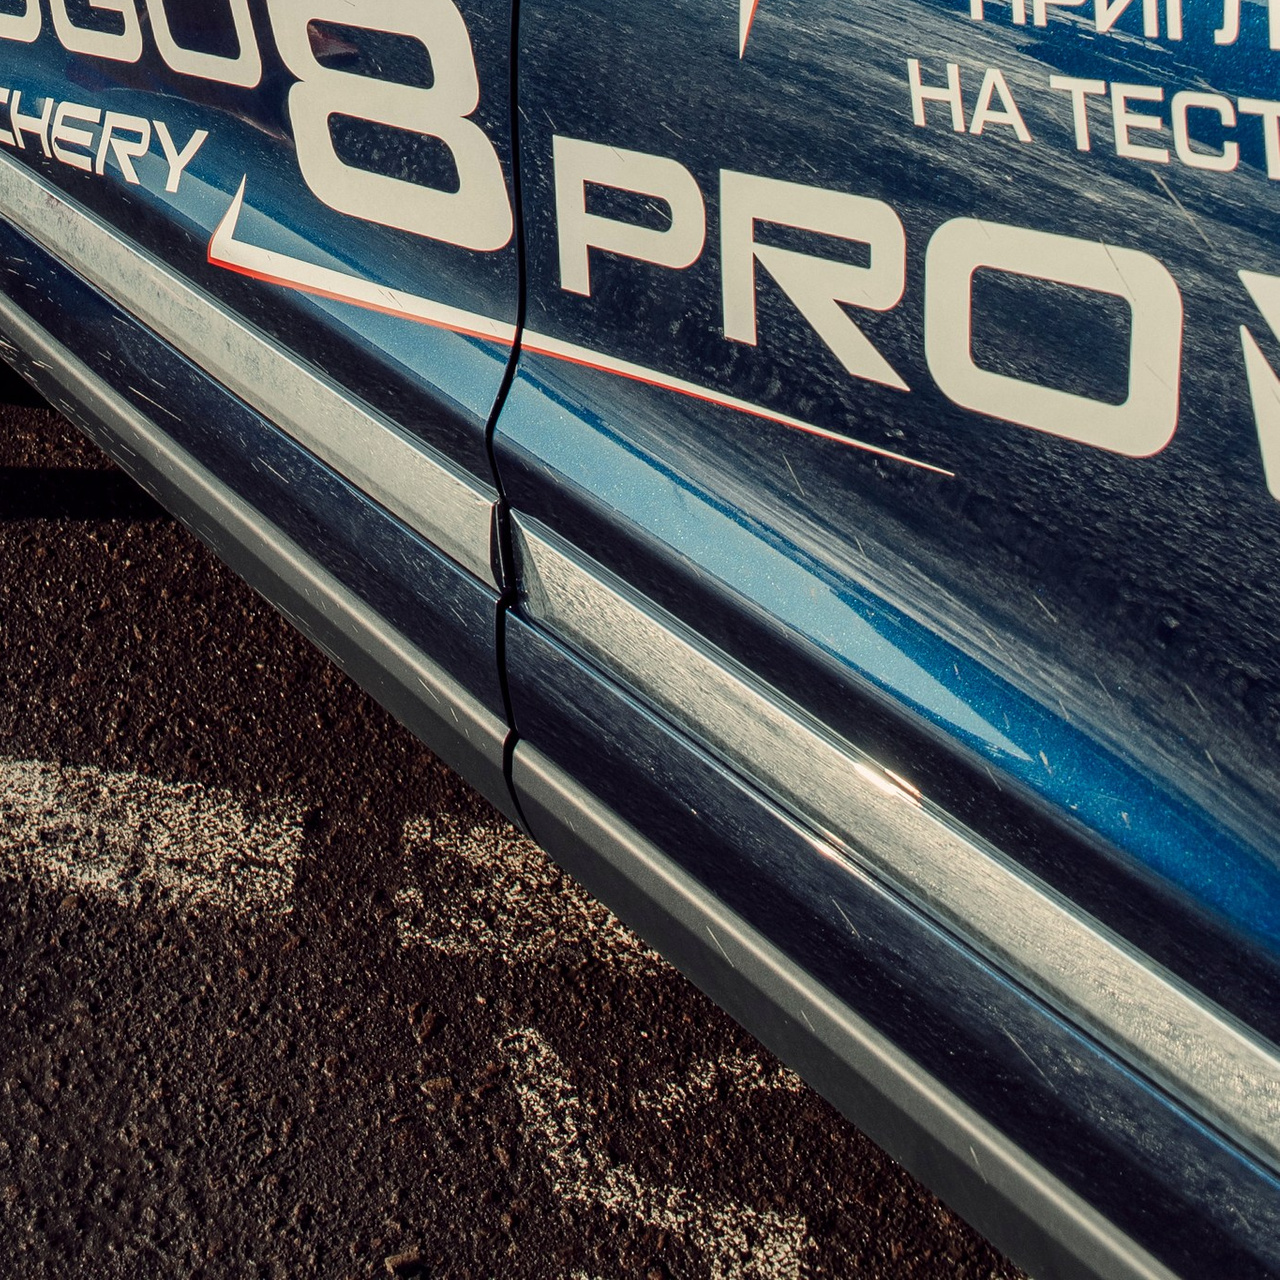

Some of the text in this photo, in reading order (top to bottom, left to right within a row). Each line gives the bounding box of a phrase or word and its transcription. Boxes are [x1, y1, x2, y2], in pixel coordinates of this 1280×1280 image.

[906, 57, 1280, 181] НА ТЕСТ
[551, 135, 1184, 459] PRO
